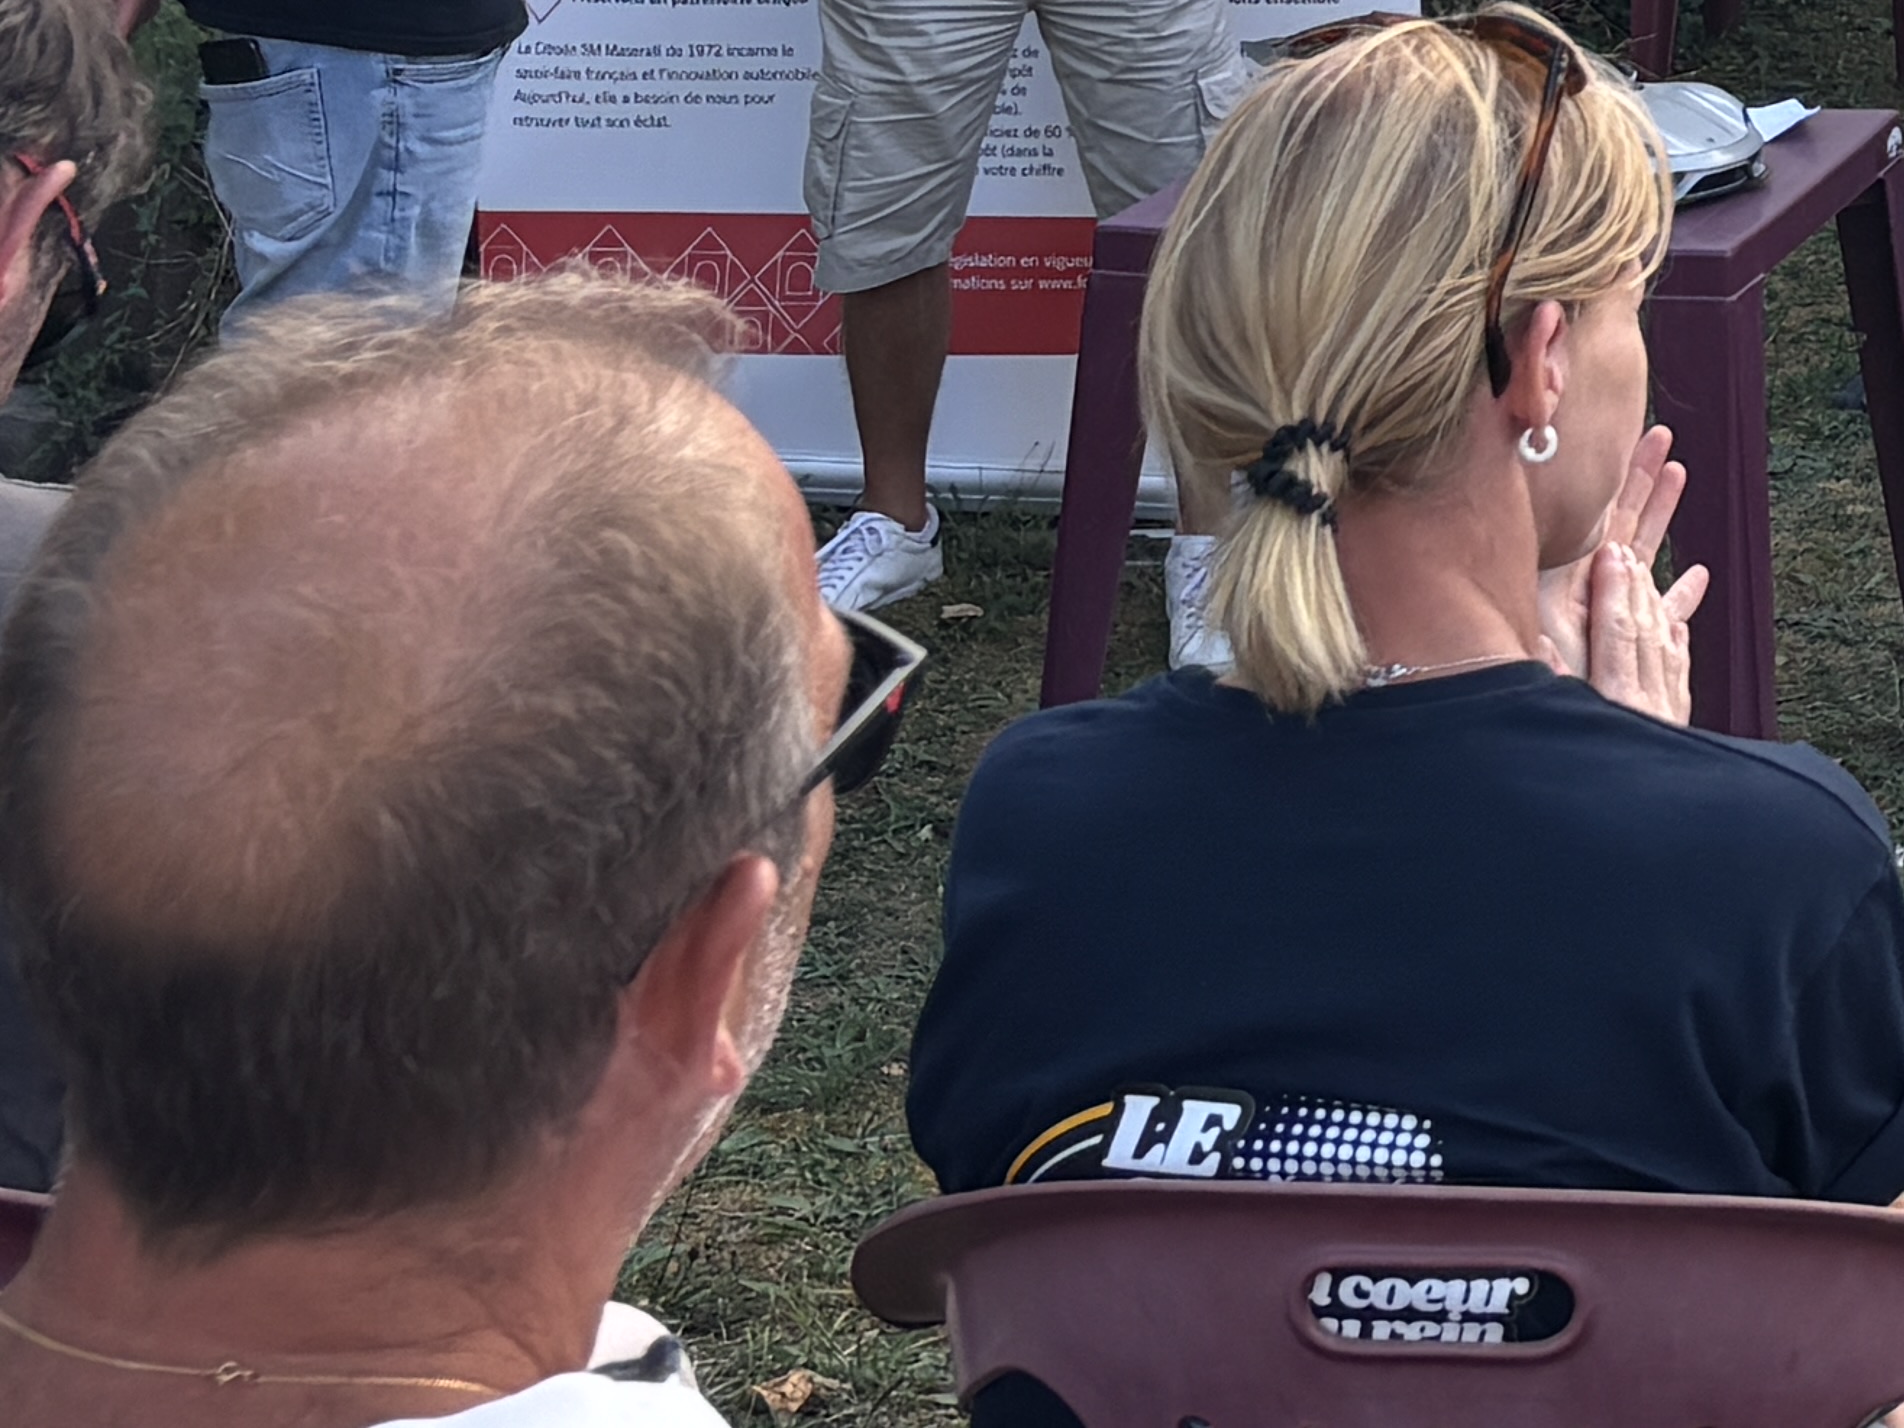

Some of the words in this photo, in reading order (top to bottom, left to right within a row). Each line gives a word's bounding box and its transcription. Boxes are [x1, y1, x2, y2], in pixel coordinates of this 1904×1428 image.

[688, 44, 722, 57] 1972
[633, 90, 680, 104] besoin
[744, 93, 775, 108] pour
[1023, 125, 1041, 139] de
[1044, 125, 1062, 139] 60
[983, 165, 1017, 177] votre
[1021, 163, 1064, 178] chiffre
[1020, 256, 1039, 267] en
[1043, 254, 1093, 272] vigueu
[1101, 1094, 1241, 1177] LE
[1338, 1274, 1530, 1315] coeur
